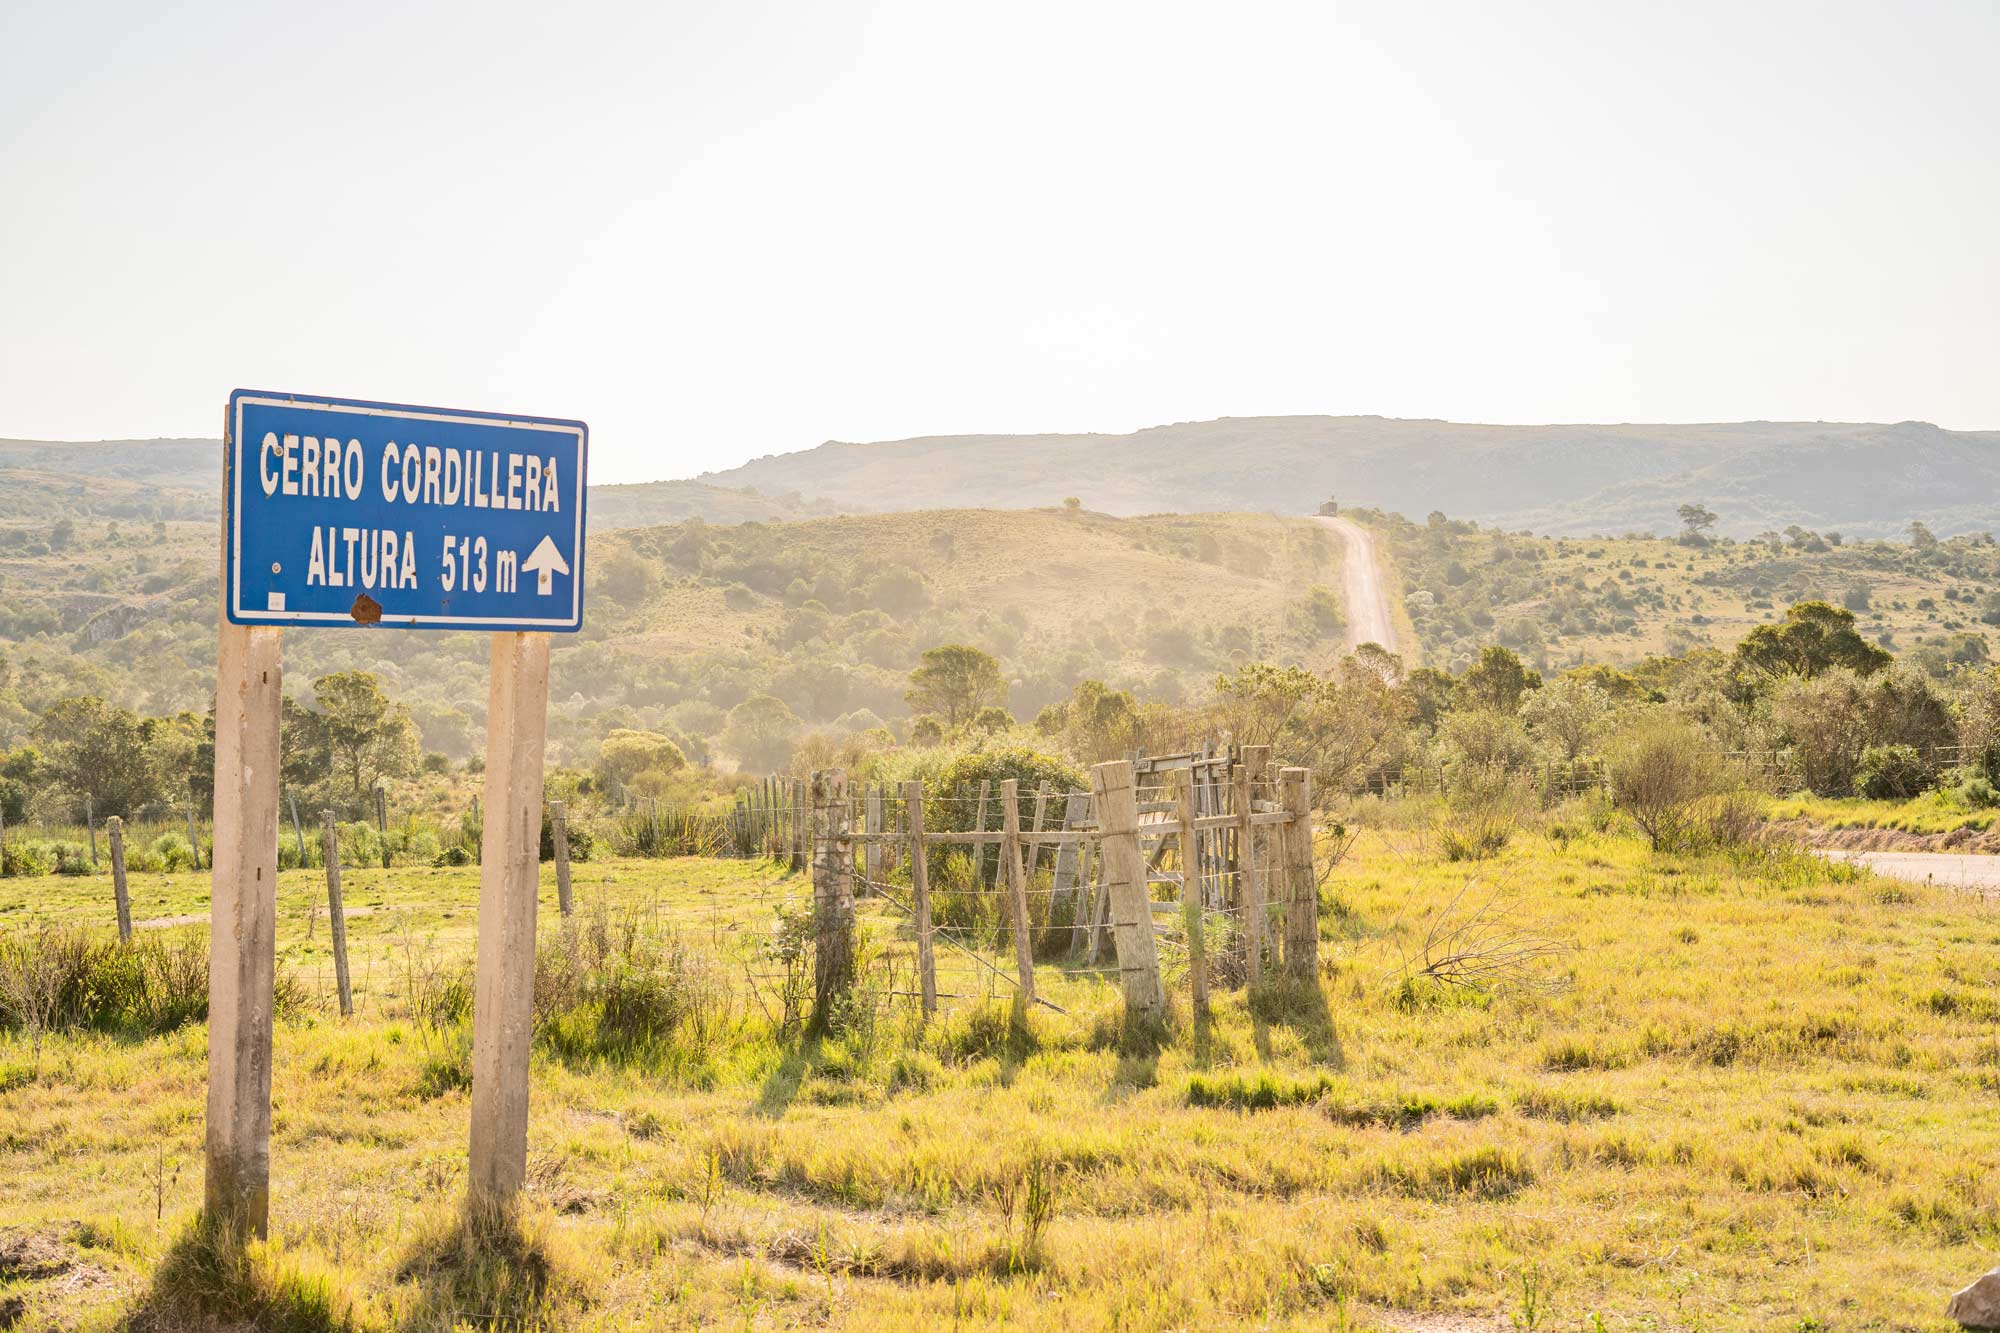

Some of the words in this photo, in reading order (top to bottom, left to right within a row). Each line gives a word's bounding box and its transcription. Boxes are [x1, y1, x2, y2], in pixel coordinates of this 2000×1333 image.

[260, 431, 364, 501] CERRO
[381, 439, 560, 513] CORDILLERA
[306, 526, 418, 590] ALTURA
[441, 535, 488, 593] 513
[495, 549, 517, 593] m
